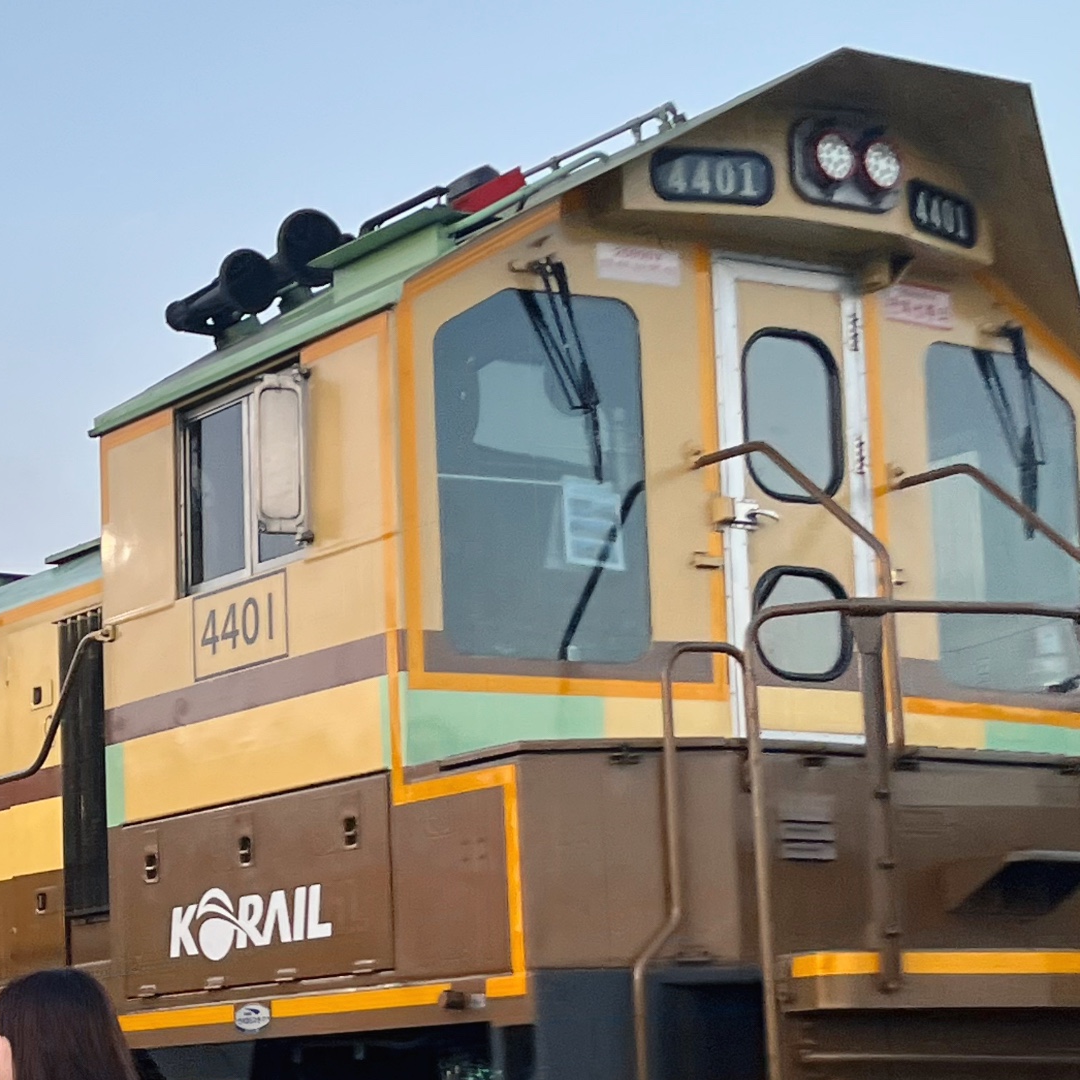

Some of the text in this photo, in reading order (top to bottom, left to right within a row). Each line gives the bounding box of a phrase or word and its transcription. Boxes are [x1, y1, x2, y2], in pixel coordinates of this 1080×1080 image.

[665, 159, 760, 197] 4401
[915, 191, 968, 240] 4401
[200, 592, 274, 655] 4401
[170, 884, 333, 961] KORAIL
